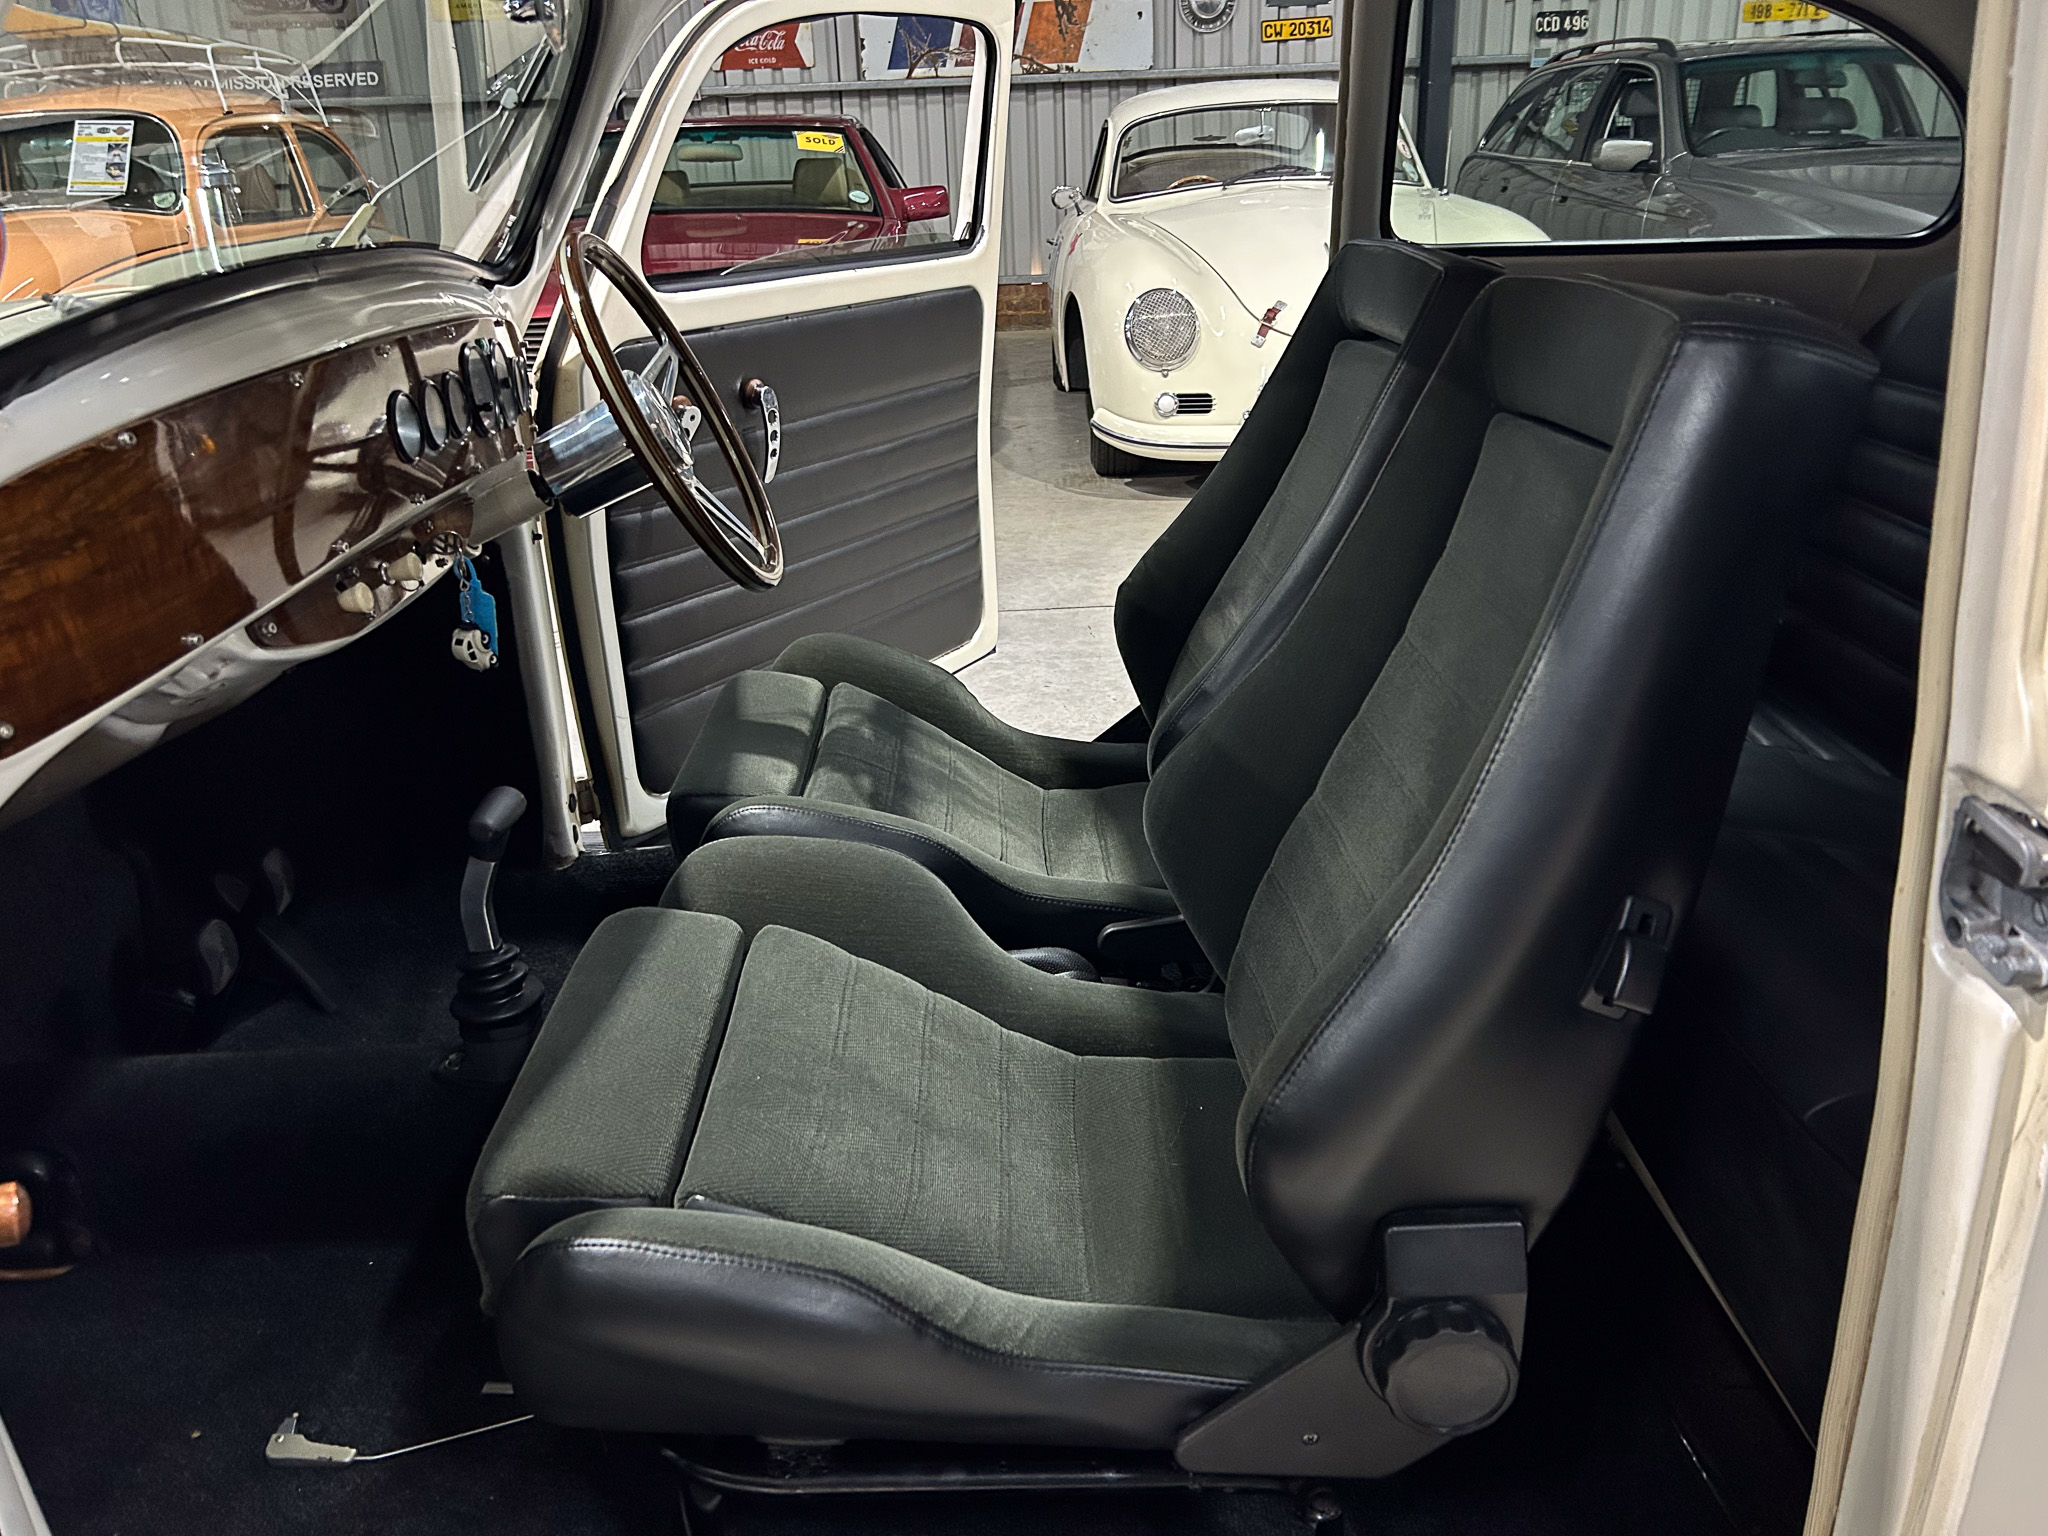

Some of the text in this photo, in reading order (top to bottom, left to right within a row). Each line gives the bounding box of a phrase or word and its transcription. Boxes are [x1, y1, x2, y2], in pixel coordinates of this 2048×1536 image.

[1264, 20, 1330, 39] CW 20314
[1536, 15, 1589, 32] CCD 496
[805, 136, 836, 145] SOLD
